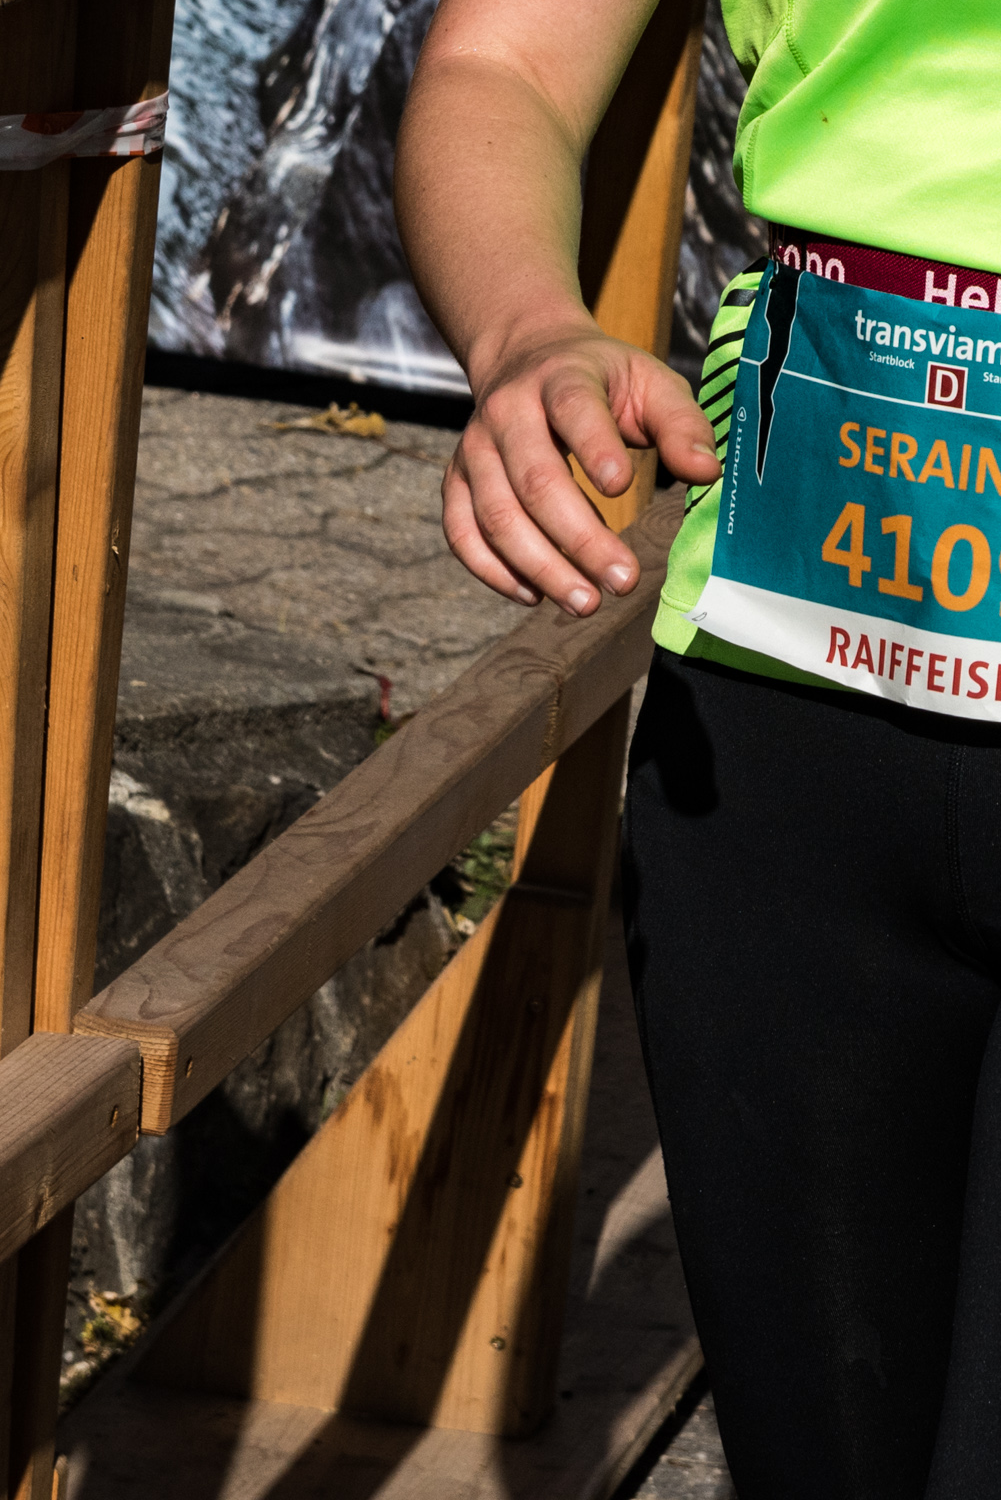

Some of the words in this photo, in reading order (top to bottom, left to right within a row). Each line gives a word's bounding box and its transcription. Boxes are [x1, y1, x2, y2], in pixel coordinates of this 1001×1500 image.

[869, 351, 915, 369] Startblock
[934, 369, 959, 402] D
[727, 424, 742, 535] DATASPORT
